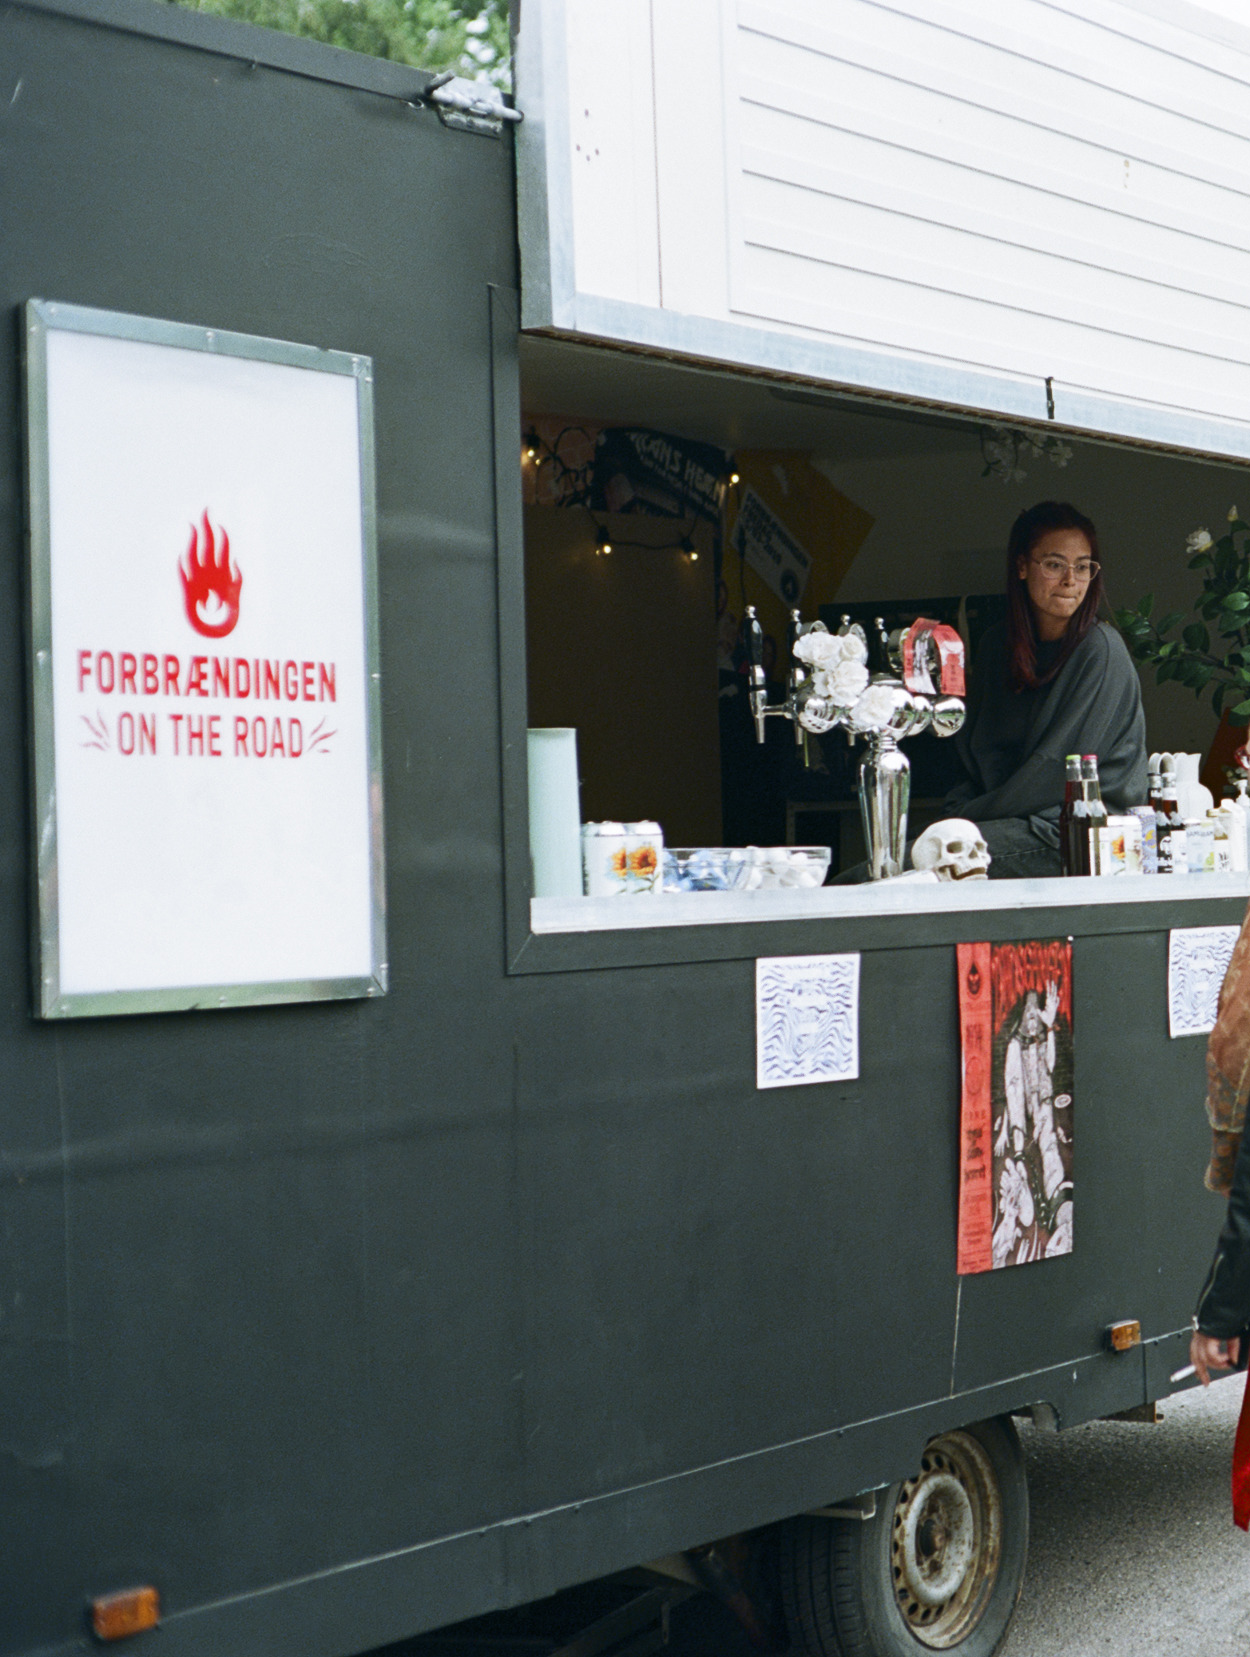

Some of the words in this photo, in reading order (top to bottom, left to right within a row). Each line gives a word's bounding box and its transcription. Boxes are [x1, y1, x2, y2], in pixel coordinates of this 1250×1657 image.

[78, 650, 337, 702] FORBRÆNDINGEN
[118, 712, 157, 756] ON
[168, 713, 223, 757] THE
[233, 716, 302, 758] ROAD
